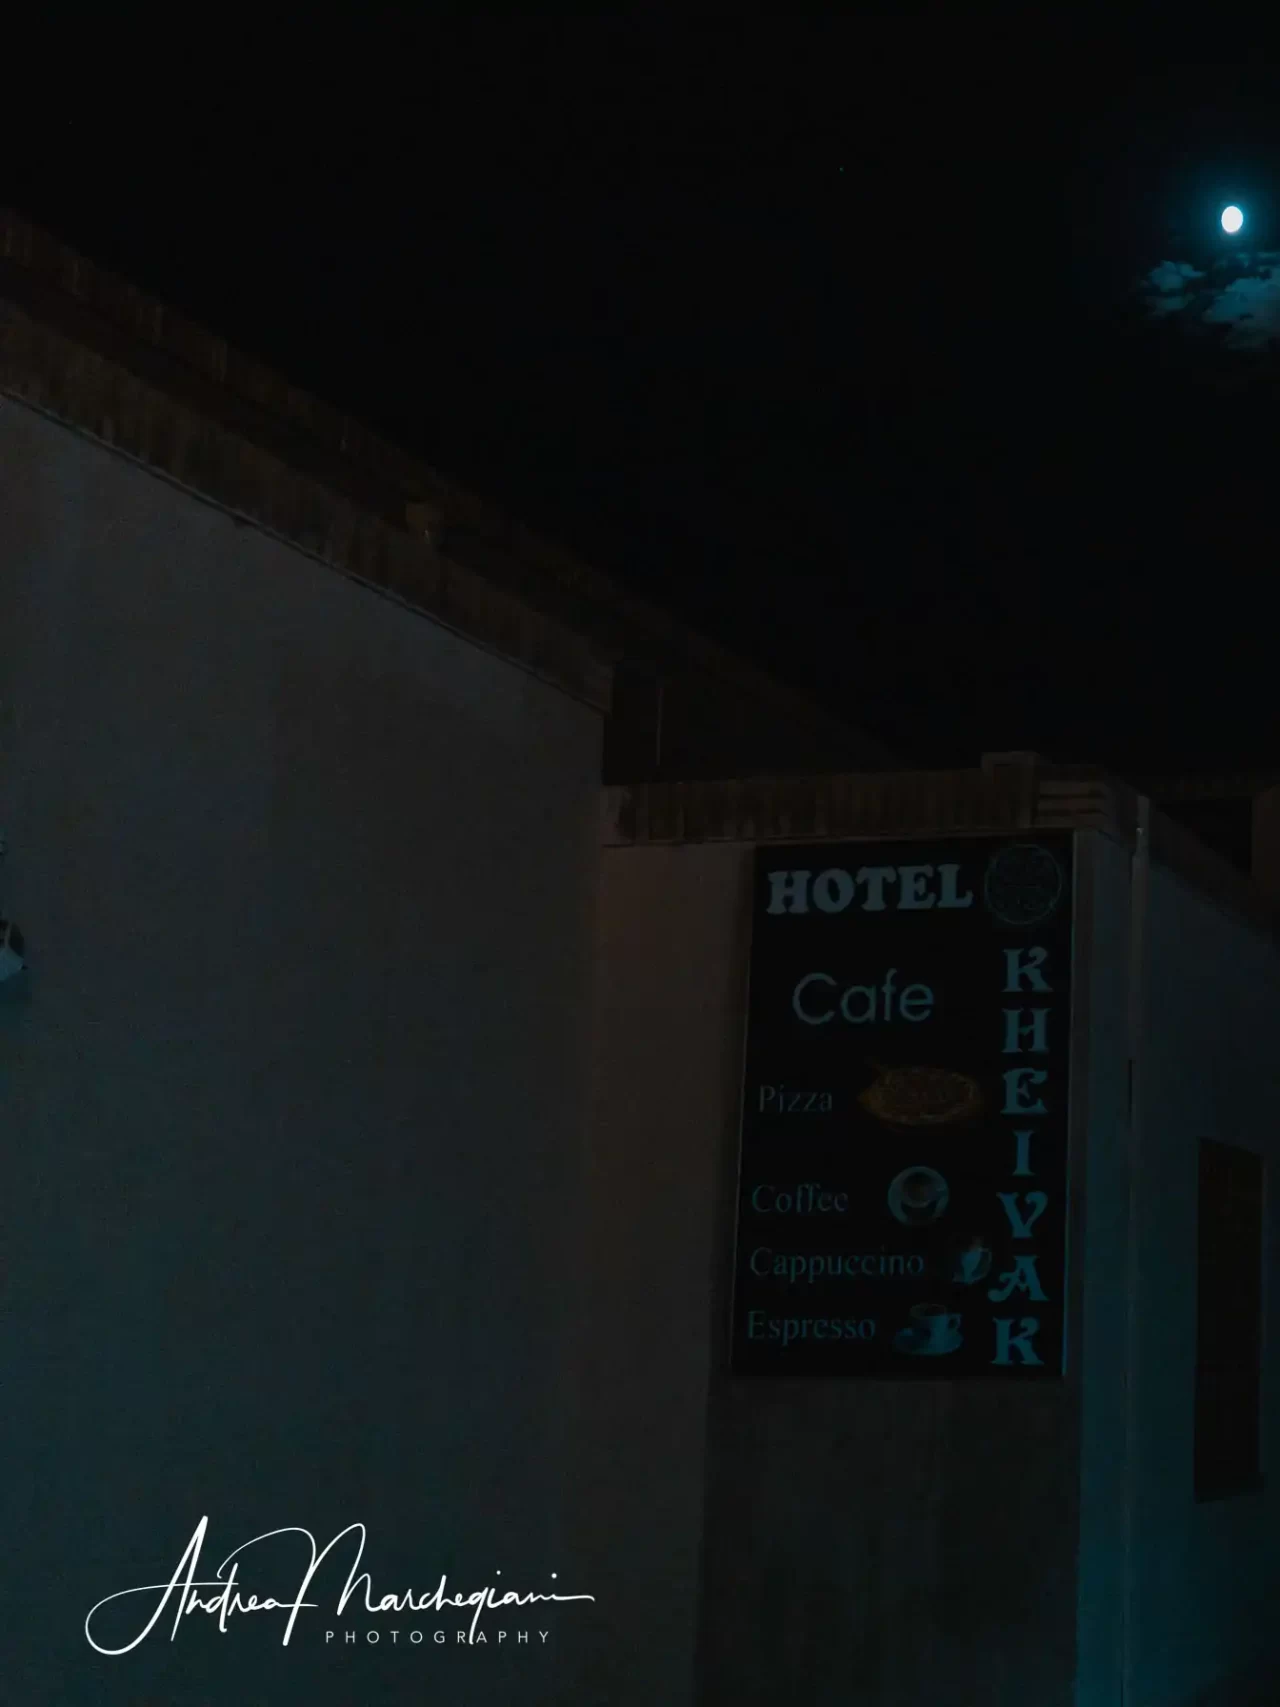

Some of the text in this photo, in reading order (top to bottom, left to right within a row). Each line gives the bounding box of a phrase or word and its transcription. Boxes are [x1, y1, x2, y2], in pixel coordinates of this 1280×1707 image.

[766, 863, 974, 914] HOTEL
[792, 968, 934, 1025] Cafe
[759, 1084, 833, 1113] Pizza
[987, 946, 1052, 1367] KHEIVAK
[751, 1183, 849, 1213] Coffee
[749, 1246, 925, 1284] Cappuccino
[747, 1310, 876, 1347] Espresso
